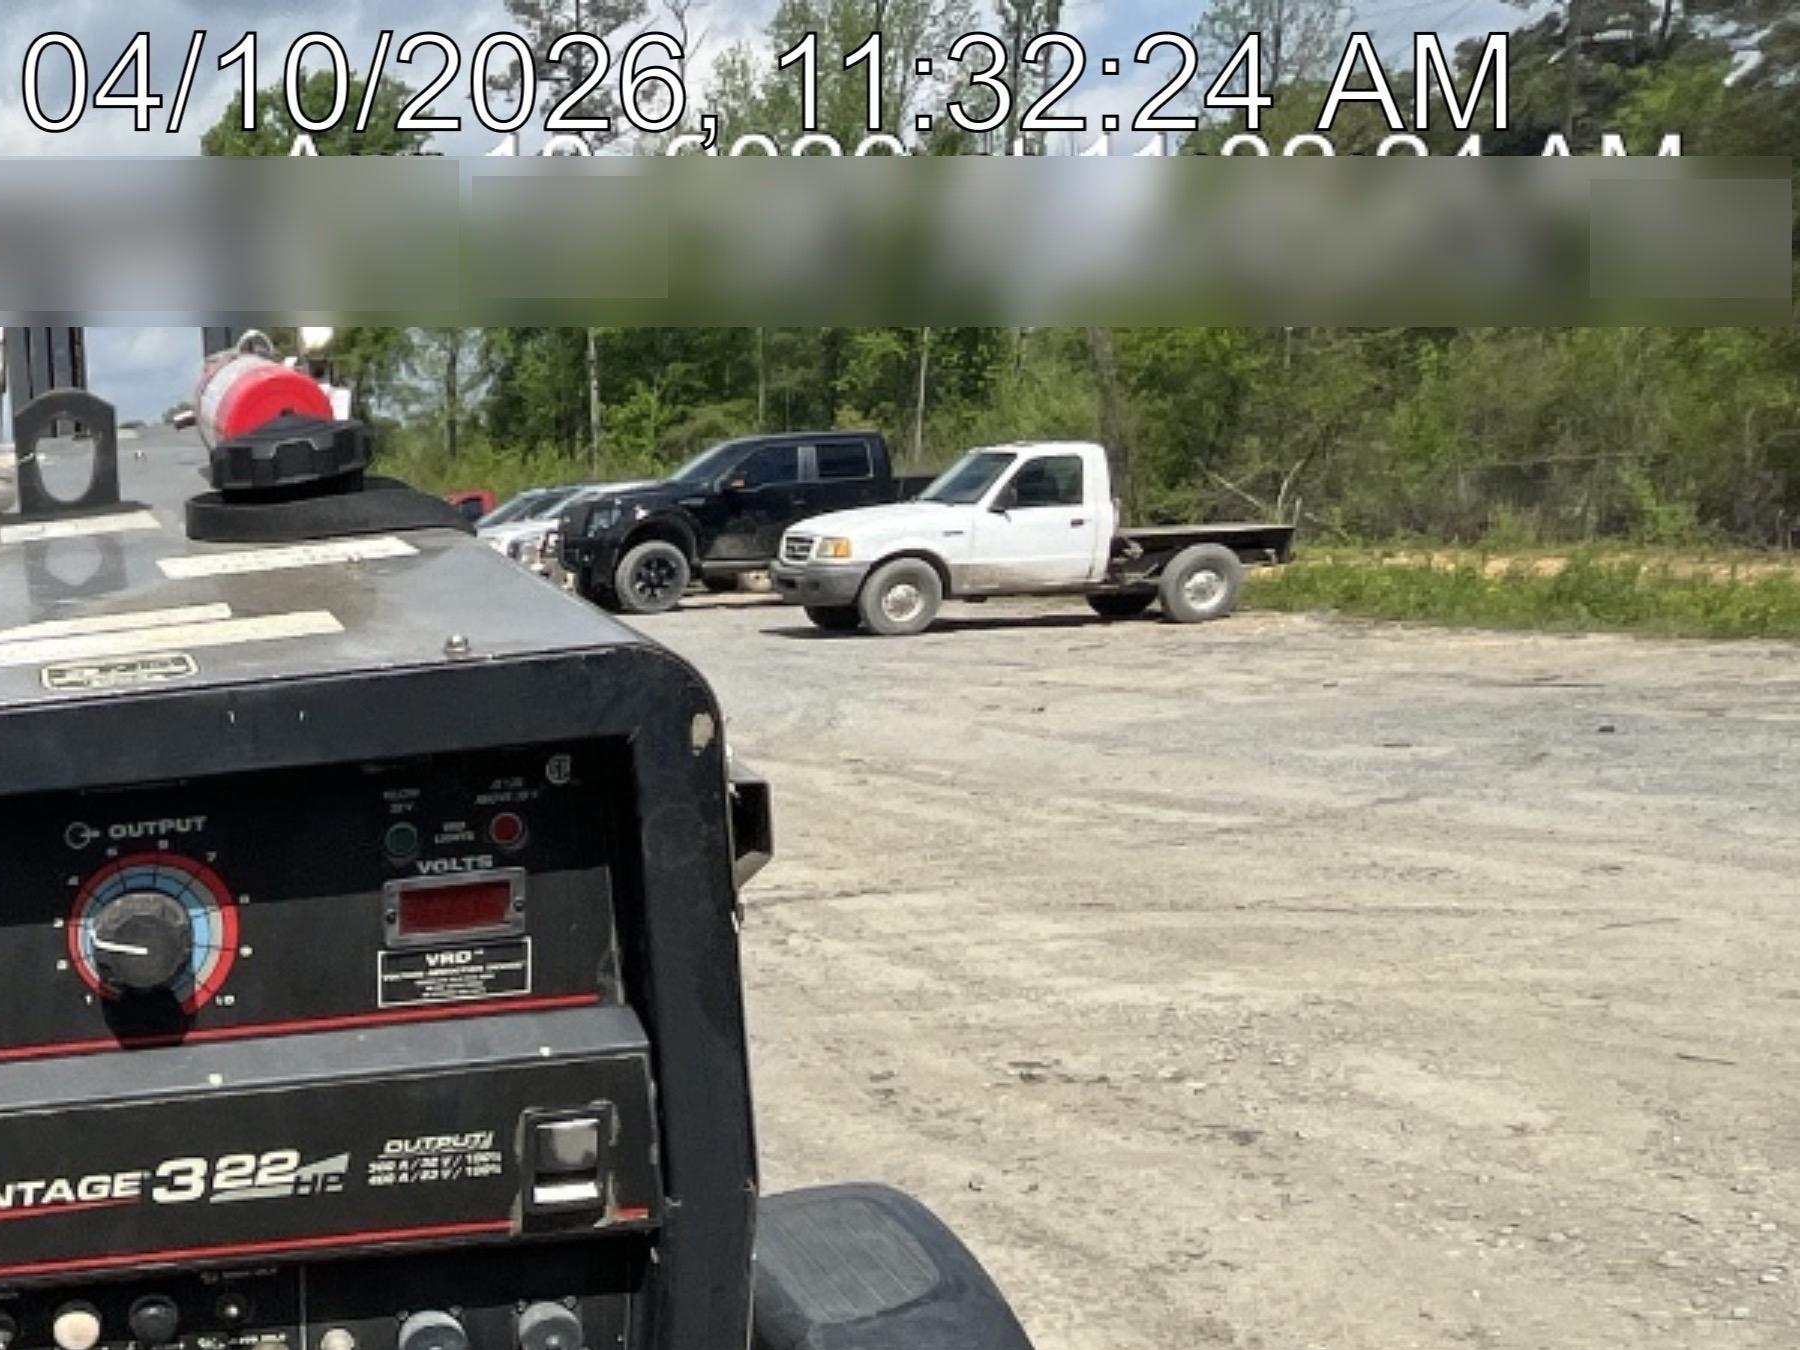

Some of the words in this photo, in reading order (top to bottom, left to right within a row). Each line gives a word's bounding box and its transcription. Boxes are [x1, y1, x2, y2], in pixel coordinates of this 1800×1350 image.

[108, 816, 207, 839] OUTPUT
[417, 854, 493, 875] VOLTS
[151, 1149, 303, 1205] 322
